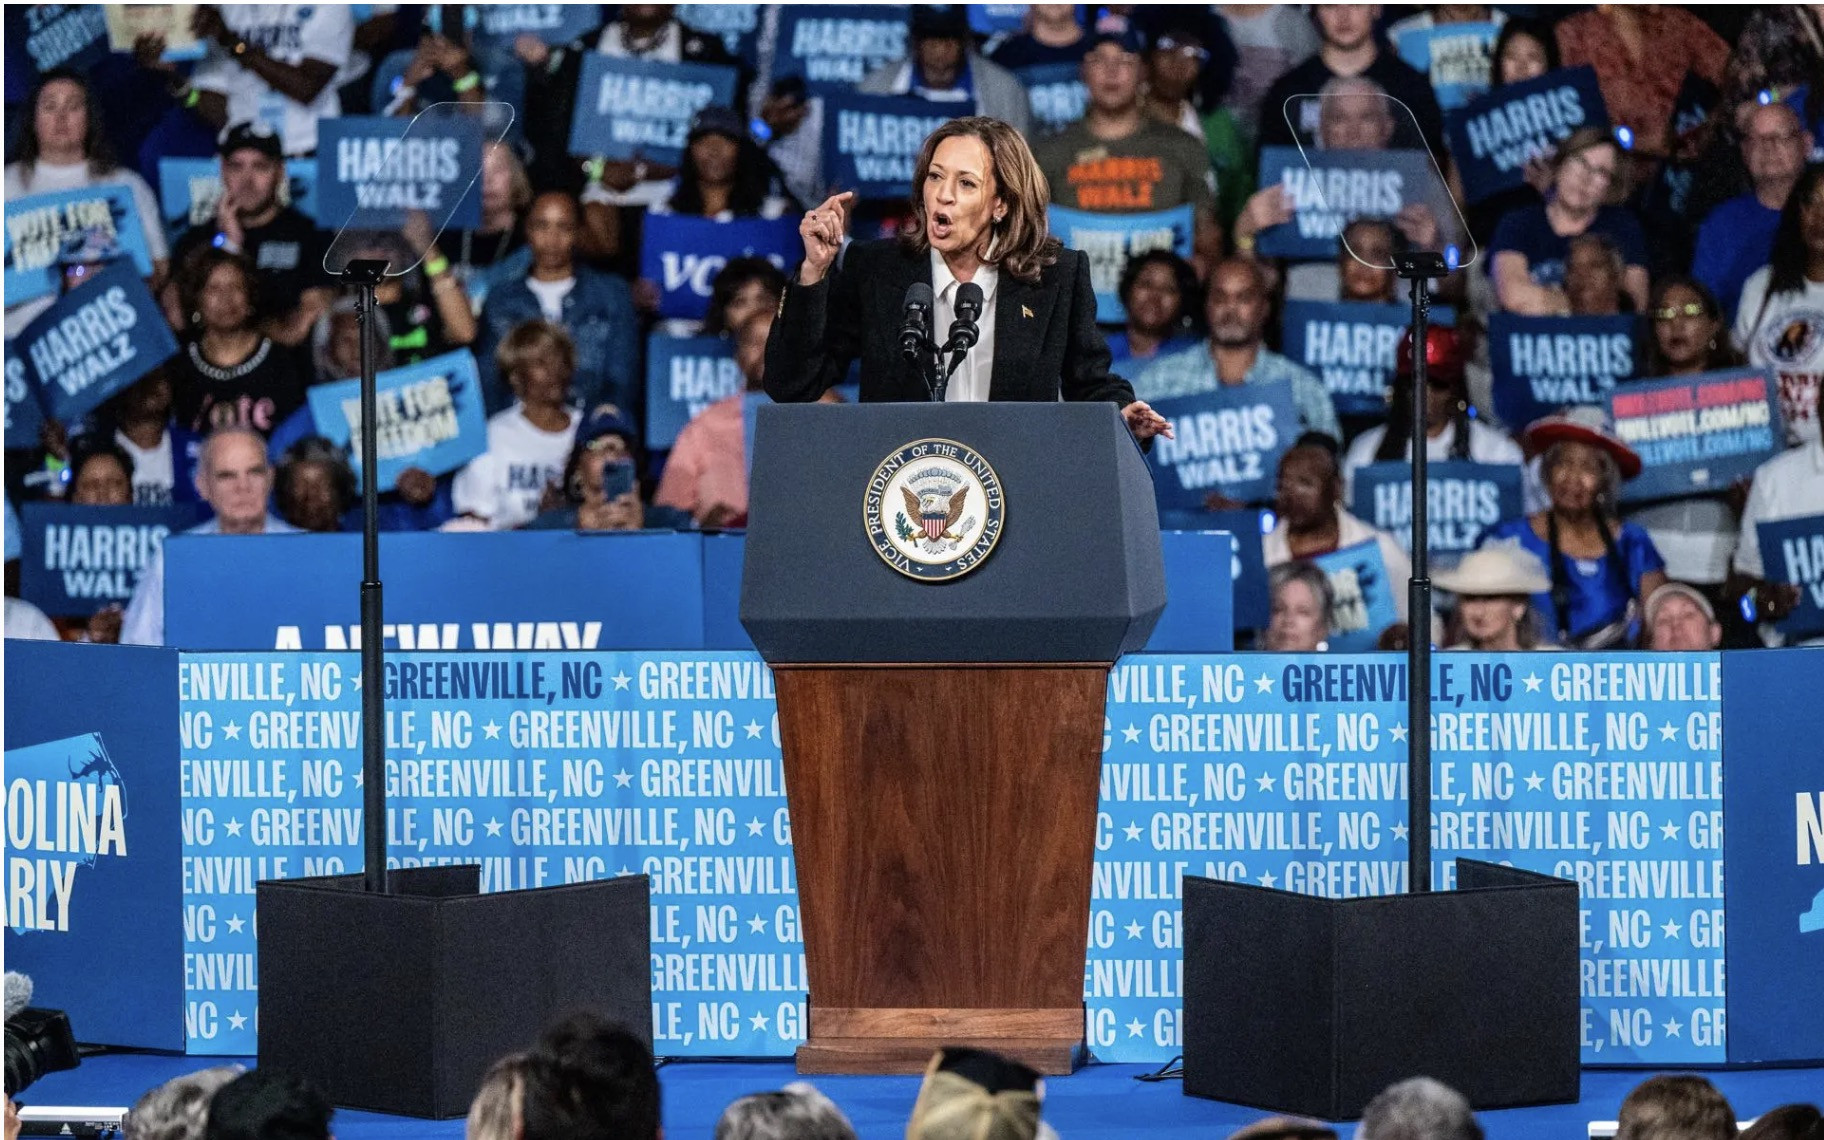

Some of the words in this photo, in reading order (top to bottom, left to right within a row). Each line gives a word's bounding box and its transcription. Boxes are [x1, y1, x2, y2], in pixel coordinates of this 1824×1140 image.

[1465, 85, 1586, 159] HARRIS
[337, 138, 460, 182] HARRIS
[353, 180, 443, 209] WALZ
[1282, 166, 1402, 214] HARRIS
[30, 286, 137, 385] HARRIS
[1305, 319, 1405, 370] HARR
[1508, 332, 1633, 377] HARRIS
[57, 331, 138, 397] WALZ
[669, 355, 742, 400] HAR
[1323, 365, 1386, 396] WAL
[341, 387, 402, 432] VTE
[911, 444, 928, 457] OF
[933, 444, 958, 458] THE
[1154, 404, 1278, 467] HARRIS
[963, 452, 1001, 510] UNITED
[1175, 450, 1265, 490] WALZ
[868, 452, 906, 535] PRESIDENT
[878, 539, 910, 572] VICE
[956, 518, 999, 570] STATES
[325, 622, 459, 650] NW
[178, 663, 296, 707] ENVILLE,
[302, 663, 342, 700] NC
[383, 661, 556, 705] GREENVILLE,
[561, 661, 602, 699] NC
[1106, 665, 1197, 709] VILLE,
[1202, 664, 1244, 703] NC
[1282, 664, 1465, 707] GREENVIE,
[1471, 663, 1512, 702] NC
[1551, 663, 1721, 702] GREENVILLE
[180, 711, 212, 749] NC
[249, 711, 426, 755] GREENVLE,
[432, 711, 471, 749] NC
[510, 711, 687, 754] GREENVILLE,
[694, 711, 733, 748] NC
[1150, 713, 1331, 758] GREENVILLE,
[1337, 713, 1379, 751] NC
[1607, 712, 1648, 750] NC
[180, 760, 297, 803] ENVILLE,
[303, 760, 342, 797] NC
[385, 760, 557, 803] GREENVILLE,
[563, 760, 603, 797] NC
[1205, 763, 1245, 801] NC
[1283, 763, 1467, 807] GREENVIE,
[1472, 762, 1514, 800] NC
[1552, 762, 1723, 800] GREENVILLE
[4, 778, 127, 857] OLINA
[182, 808, 213, 846] NC
[251, 808, 428, 852] GREENVLE,
[433, 808, 473, 846] NC
[511, 808, 689, 851] GREENVILLE,
[695, 808, 735, 846] NC
[1151, 812, 1333, 856] GREENVILLE,
[1338, 812, 1380, 850] NC
[1608, 811, 1649, 850] NC
[4, 857, 77, 932] RLY
[1286, 861, 1457, 898] GREENVIE
[183, 905, 216, 943] NC
[697, 905, 737, 943] NC
[1609, 910, 1651, 948] NC
[186, 1002, 218, 1039] NC
[698, 1002, 739, 1040] NC
[1610, 1008, 1652, 1047] NC
